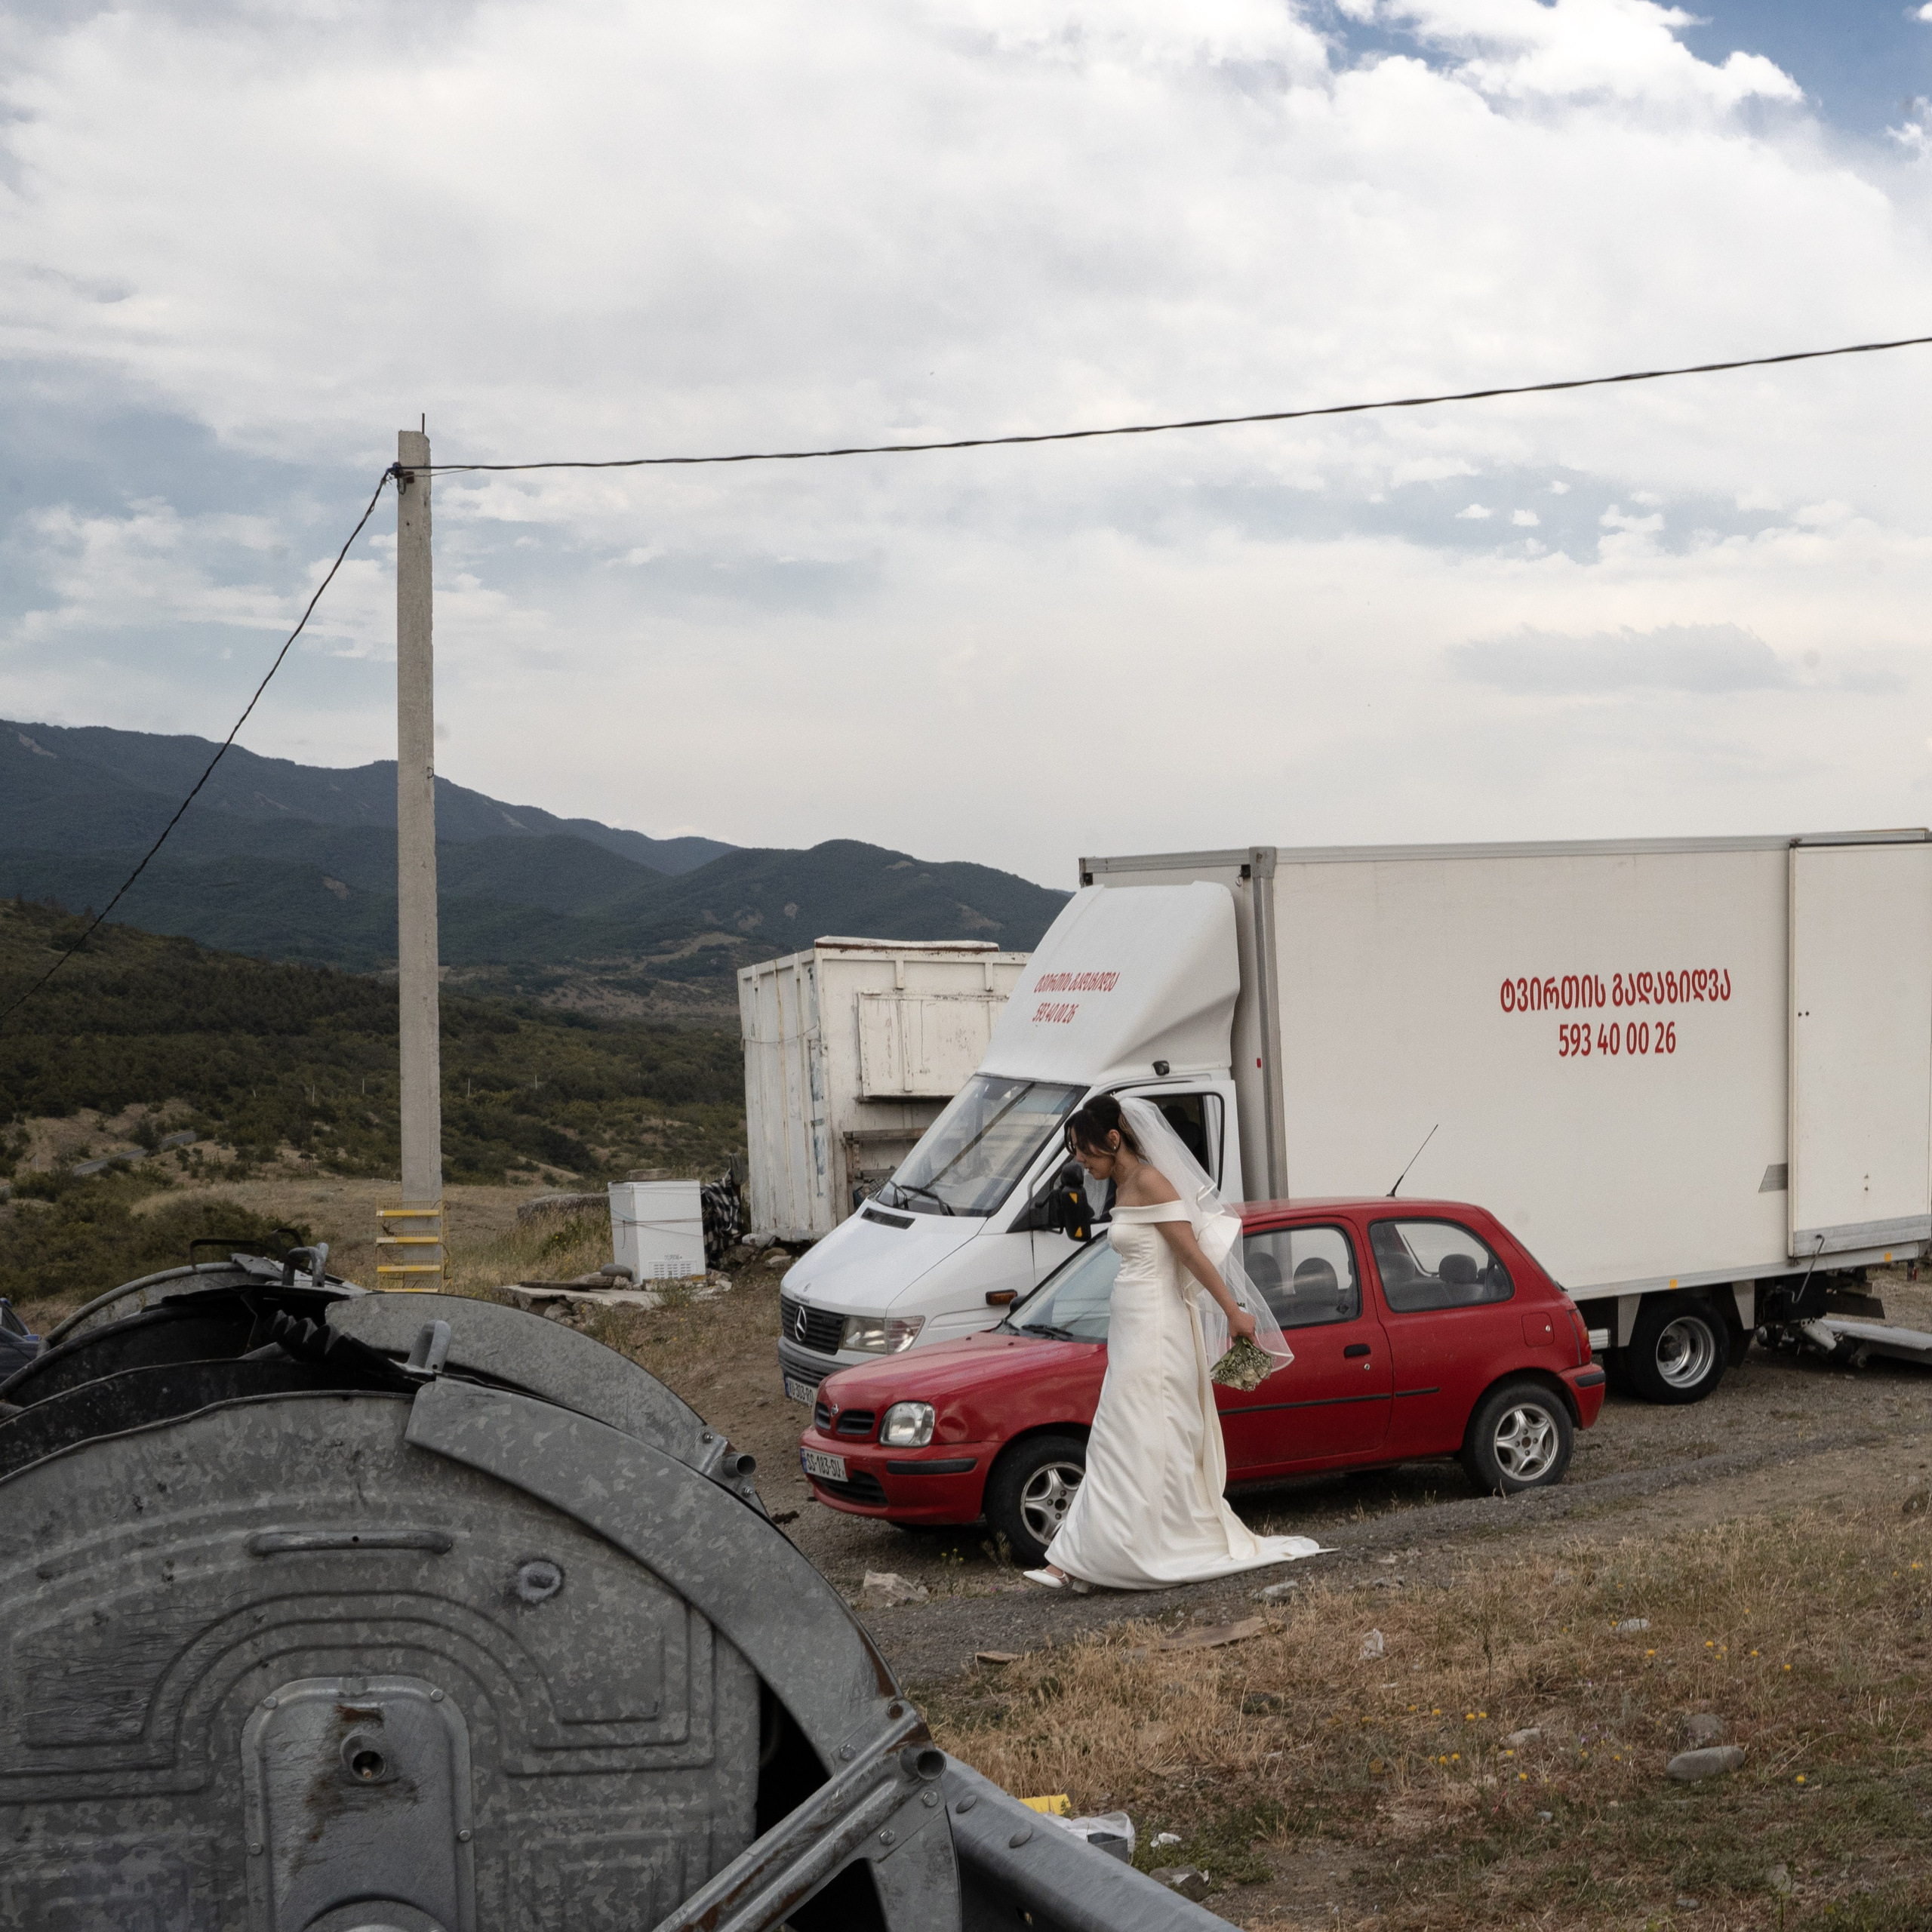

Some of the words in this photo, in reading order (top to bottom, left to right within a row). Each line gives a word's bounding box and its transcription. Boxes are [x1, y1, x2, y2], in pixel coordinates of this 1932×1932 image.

[1500, 974, 1606, 1013] ტვირთის
[1612, 968, 1732, 1007] გადაზიდვა
[1558, 1023, 1592, 1057] 593
[1597, 1022, 1621, 1056] 40
[1626, 1021, 1650, 1055] 00
[1654, 1021, 1677, 1054] 26
